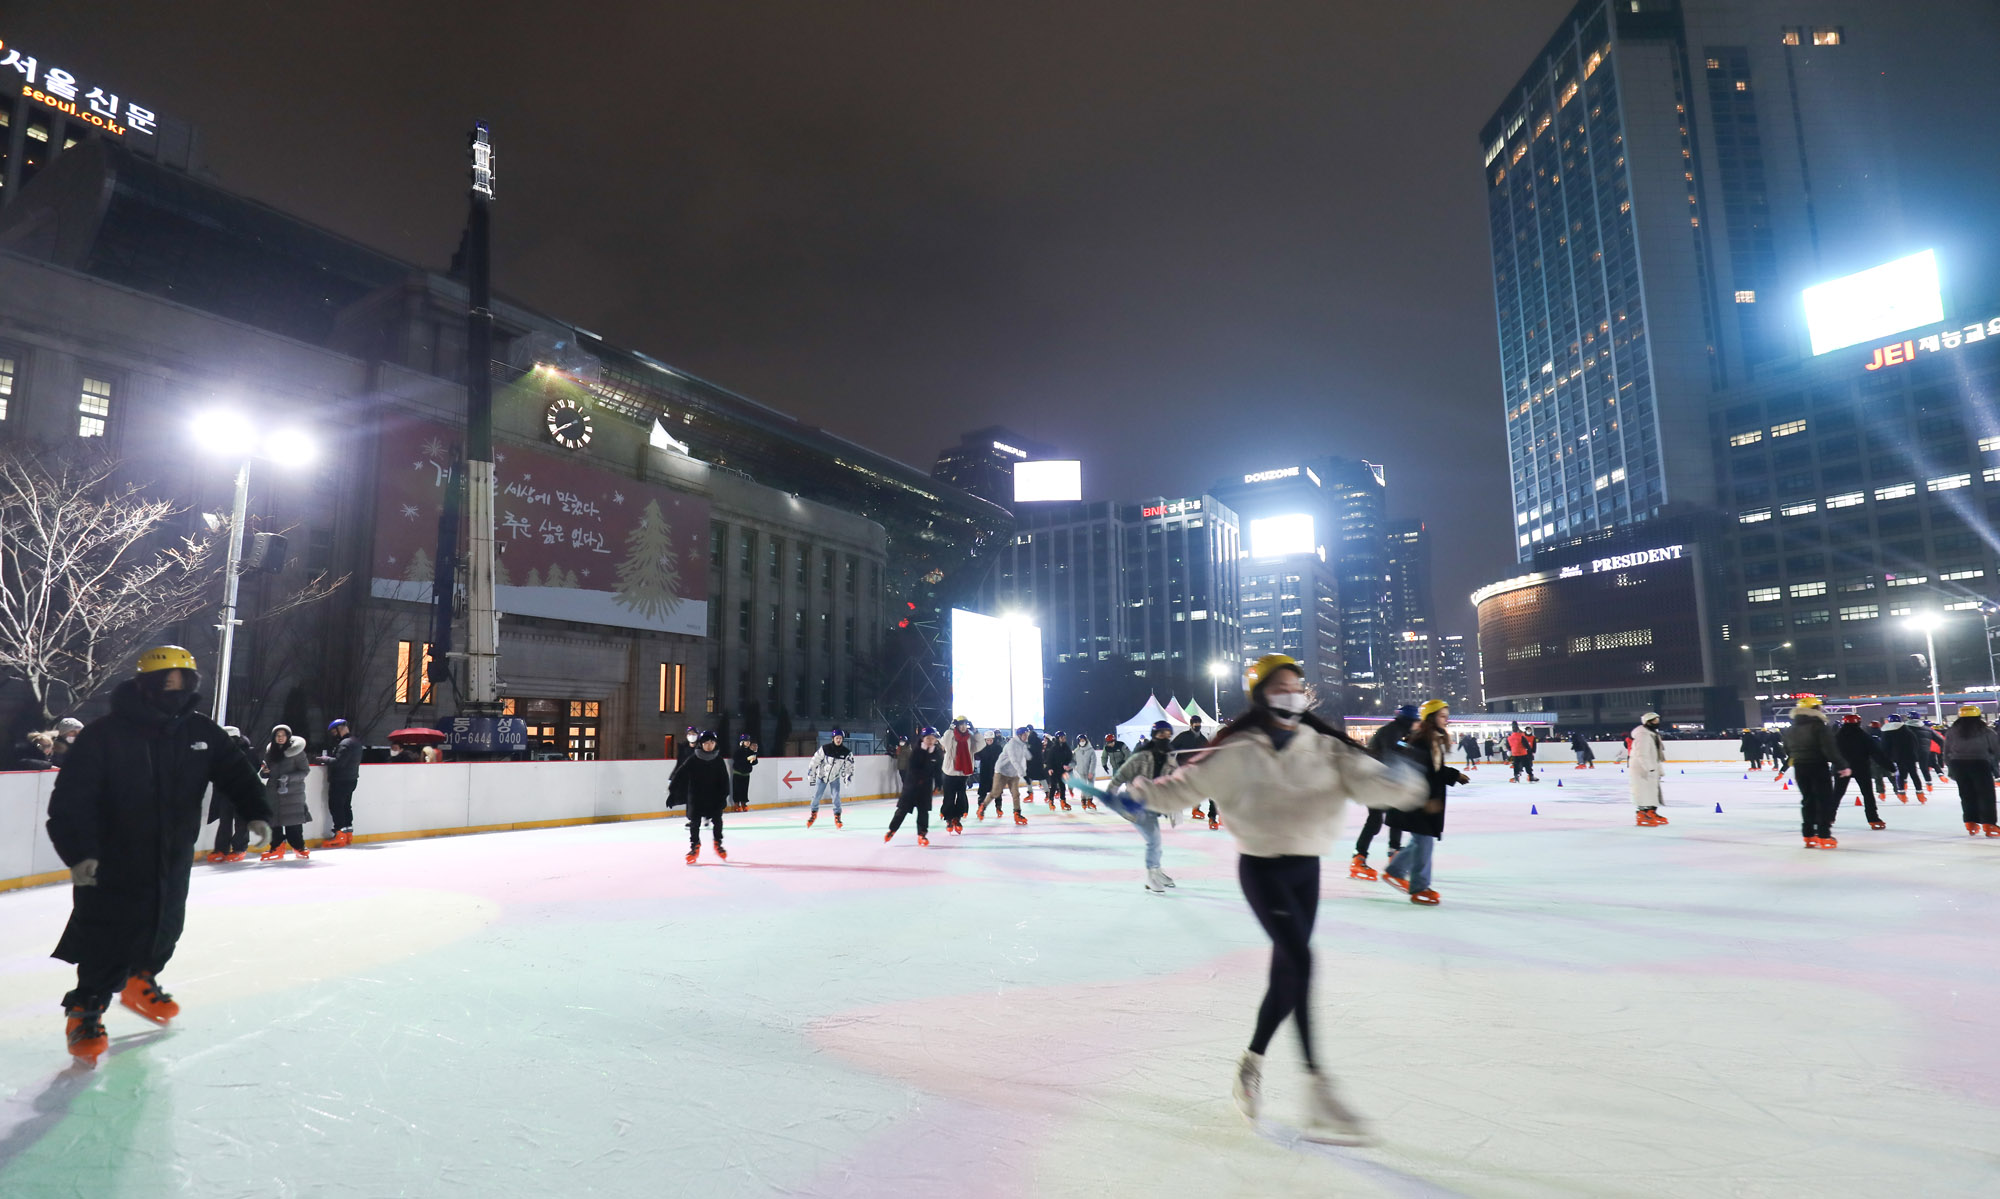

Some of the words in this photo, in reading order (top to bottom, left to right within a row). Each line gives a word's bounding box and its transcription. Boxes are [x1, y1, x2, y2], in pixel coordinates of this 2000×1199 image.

[0, 49, 157, 135] 서울신문
[22, 85, 127, 135] seoul.co.kr
[1865, 340, 1915, 371] JEI
[1244, 466, 1300, 484] DOUZONE
[504, 481, 551, 505] 세상에
[1143, 505, 1168, 518] BNK
[502, 510, 532, 540] 추운
[539, 519, 565, 545] 삶은
[571, 527, 612, 554] 없다고
[1592, 545, 1683, 573] PRESIDENT
[499, 733, 521, 744] 0400
